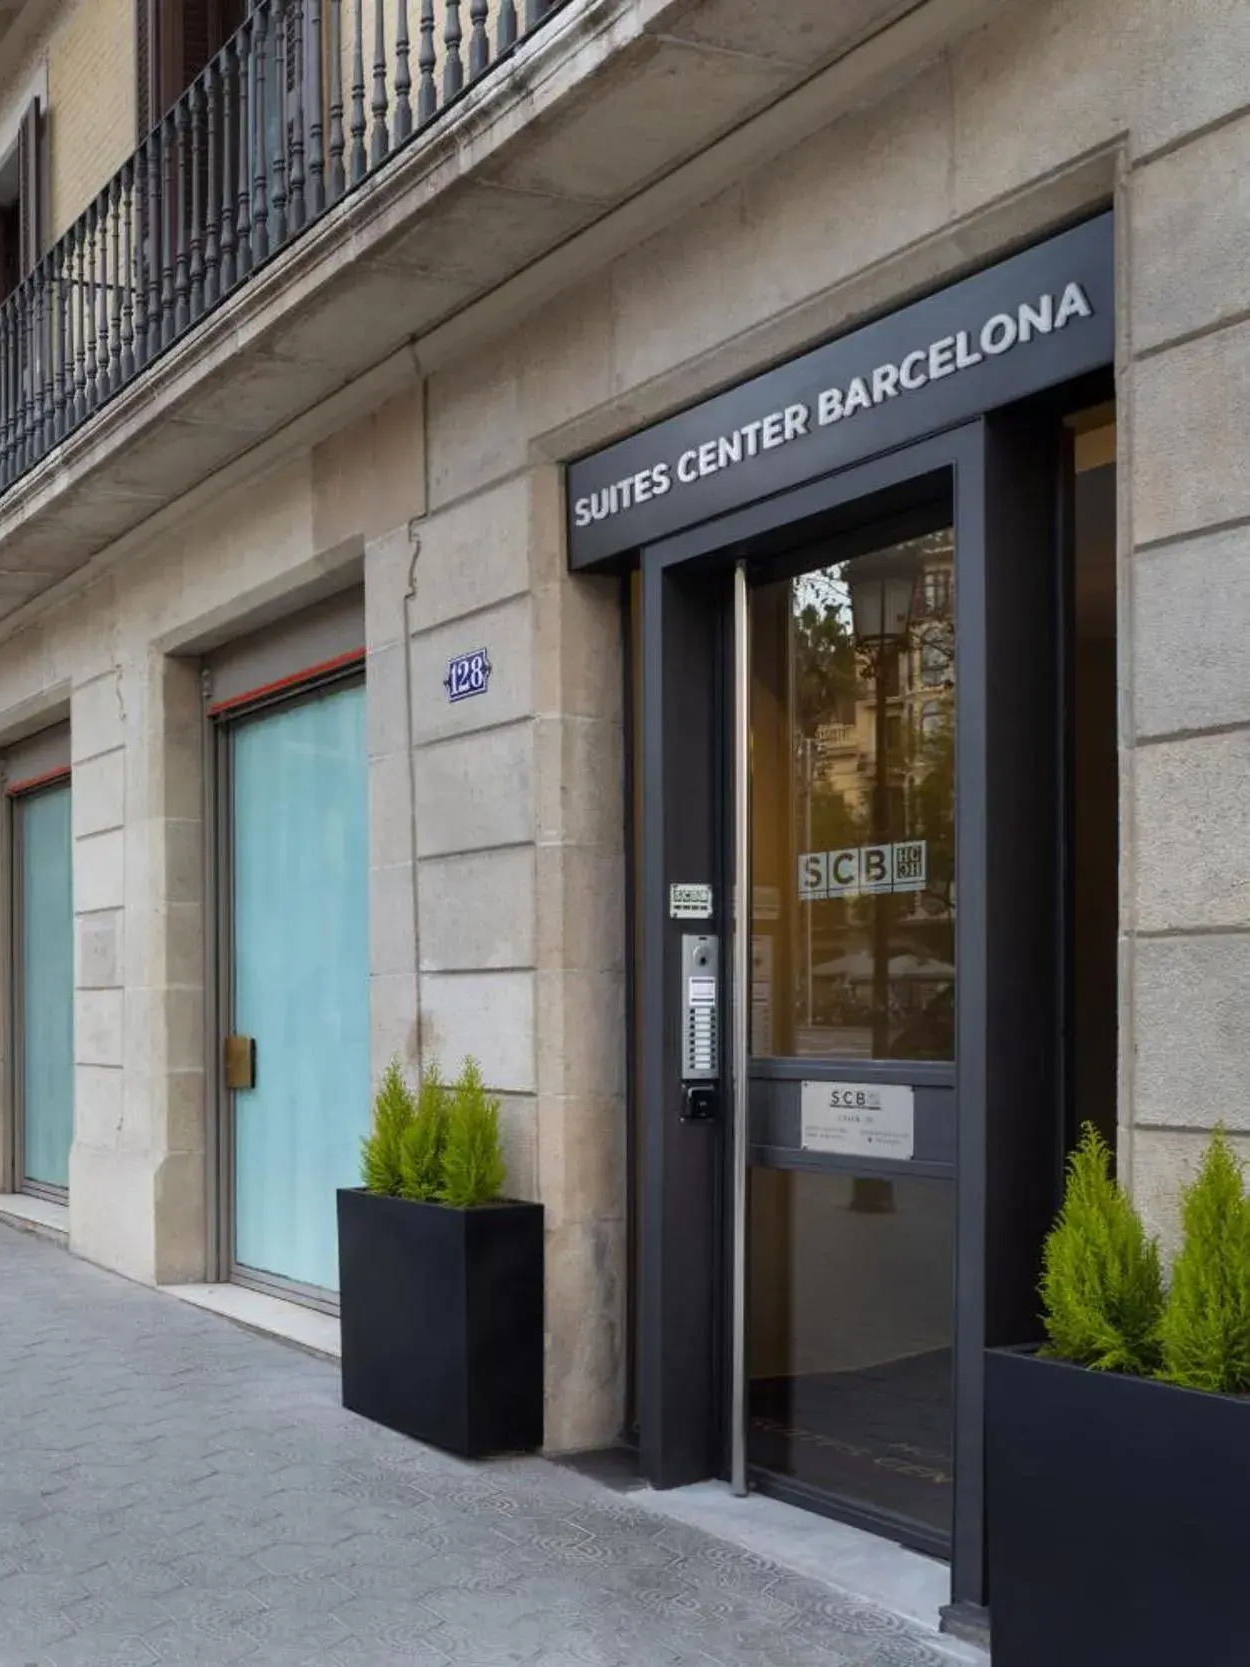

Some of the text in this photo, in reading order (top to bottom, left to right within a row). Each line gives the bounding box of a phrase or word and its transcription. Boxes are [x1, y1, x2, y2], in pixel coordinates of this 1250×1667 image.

[575, 281, 1092, 527] SUITES CENTER BARCELONA
[451, 656, 483, 695] 128
[804, 848, 887, 888] SCB
[831, 1090, 867, 1106] SCB
